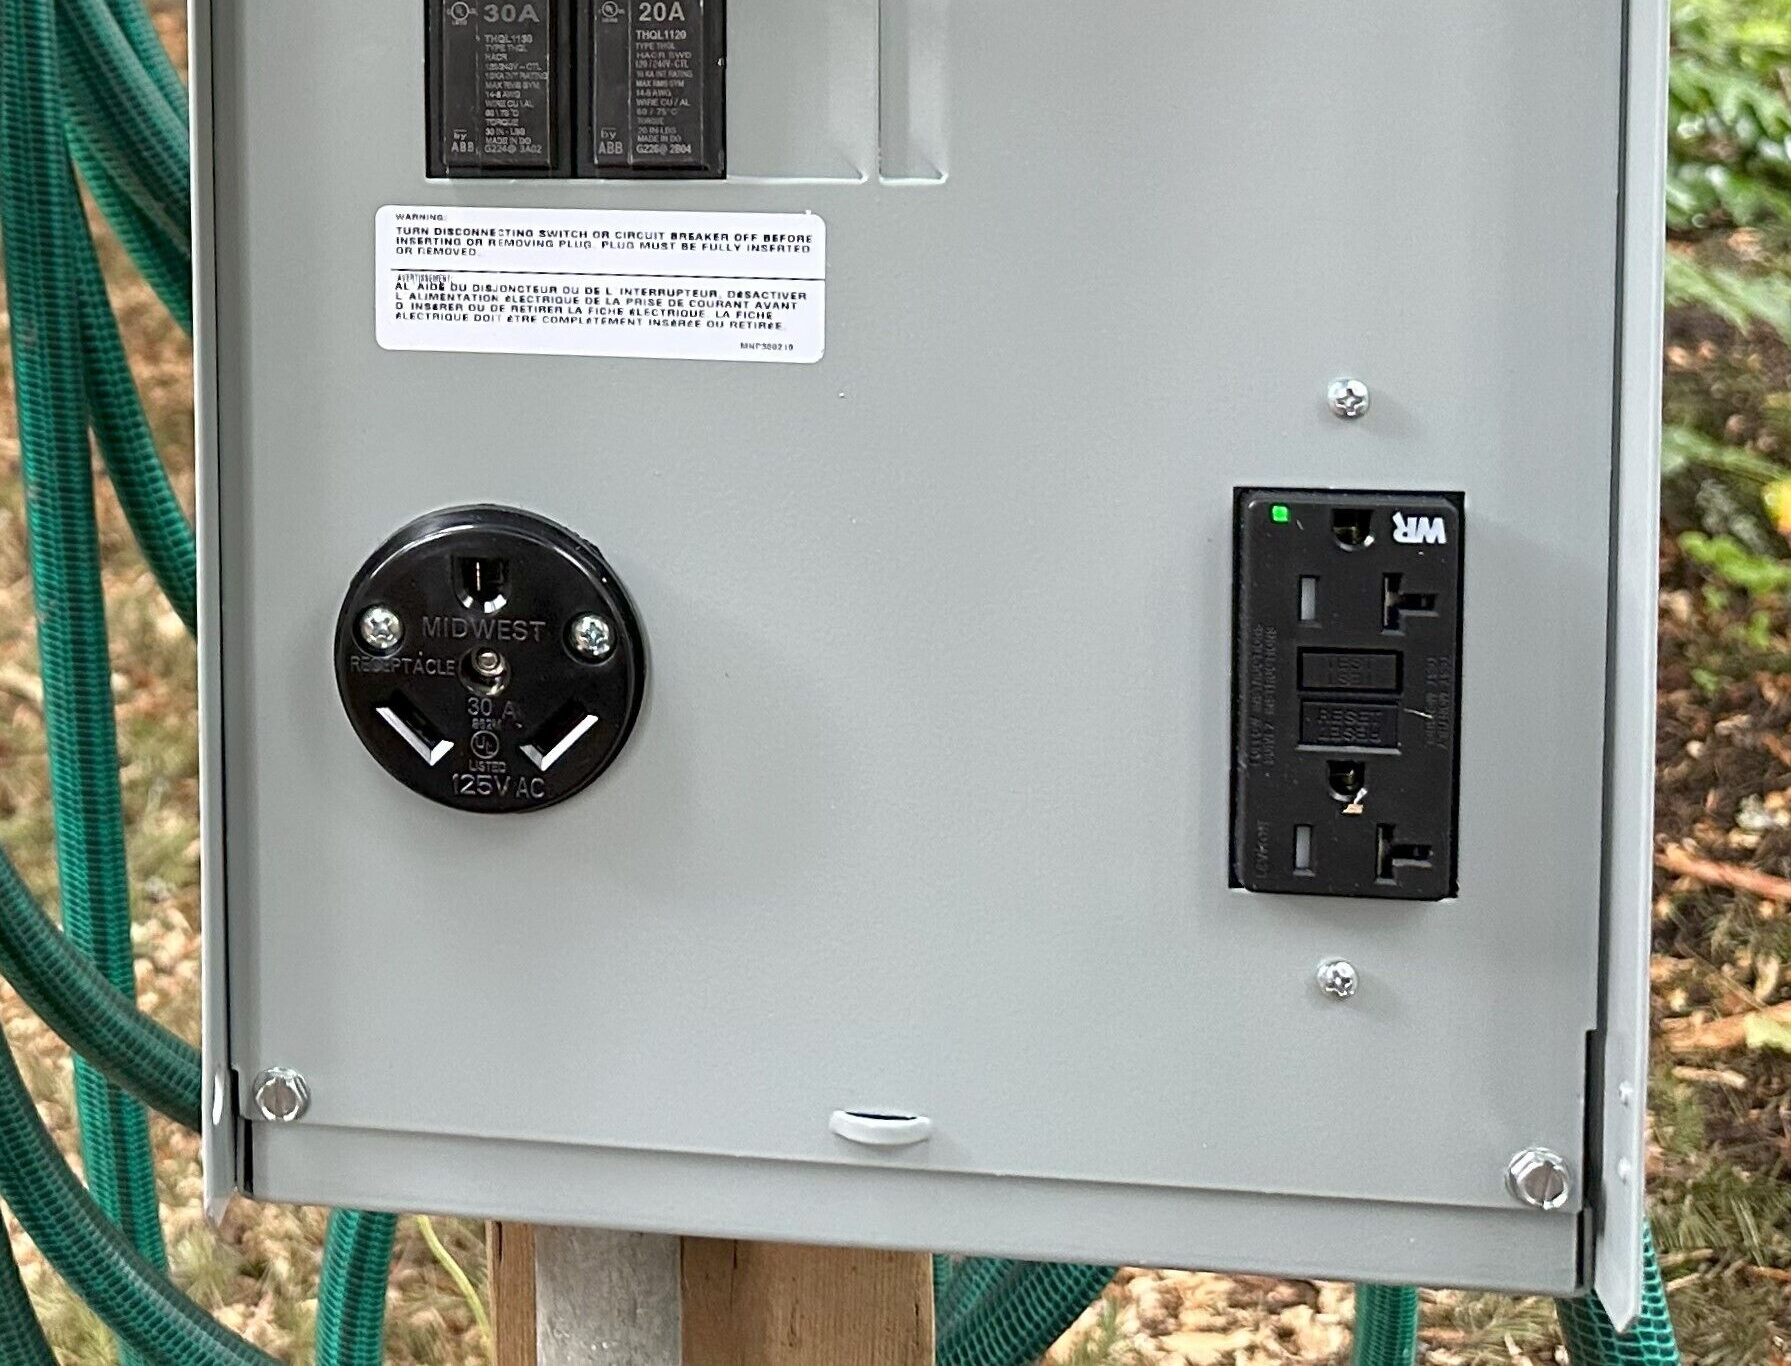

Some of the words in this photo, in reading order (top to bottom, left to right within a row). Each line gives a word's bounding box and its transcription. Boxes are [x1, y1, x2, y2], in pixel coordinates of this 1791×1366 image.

[483, 4, 539, 22] 30A
[638, 2, 685, 22] 20A
[451, 141, 474, 153] ABB
[598, 141, 623, 154] ABB
[395, 226, 429, 235] TURN
[433, 227, 533, 237] DISCONNECTING
[538, 229, 587, 238] SWITCH
[592, 230, 610, 239] OR
[614, 230, 665, 240] CIRCUIT
[670, 231, 728, 241] BREAKER
[733, 232, 757, 242] OFF
[762, 233, 812, 243] BEFORE
[395, 236, 461, 246] INSERTING
[466, 237, 482, 246] OR
[487, 238, 553, 247] REMOVING
[601, 240, 634, 249] PLUG
[639, 241, 676, 250] MUST
[680, 242, 696, 251] BE
[701, 242, 741, 251] FULLY
[746, 243, 810, 253] INSERTED
[395, 246, 412, 255] OR
[449, 280, 467, 292] DU
[472, 283, 557, 294] DISJONCTEUR
[562, 285, 579, 294] OU
[584, 286, 600, 295] DE
[467, 303, 485, 312] OU
[489, 303, 505, 312] DE
[510, 304, 562, 314] RETIRER
[567, 306, 582, 314] LA
[587, 306, 624, 315] FICHE
[715, 309, 730, 318] LA
[735, 310, 772, 320] FICHE
[584, 296, 600, 305] DE
[604, 296, 620, 305] LA
[625, 297, 662, 307] PRISE
[667, 298, 684, 307] DE
[688, 298, 749, 309] COURANT
[754, 300, 797, 310] AVANT
[1392, 511, 1448, 544] WR
[422, 616, 546, 642] MIDWEST
[350, 656, 456, 676] RECEPTACLE
[467, 697, 492, 716] 30
[469, 760, 507, 773] LISTED
